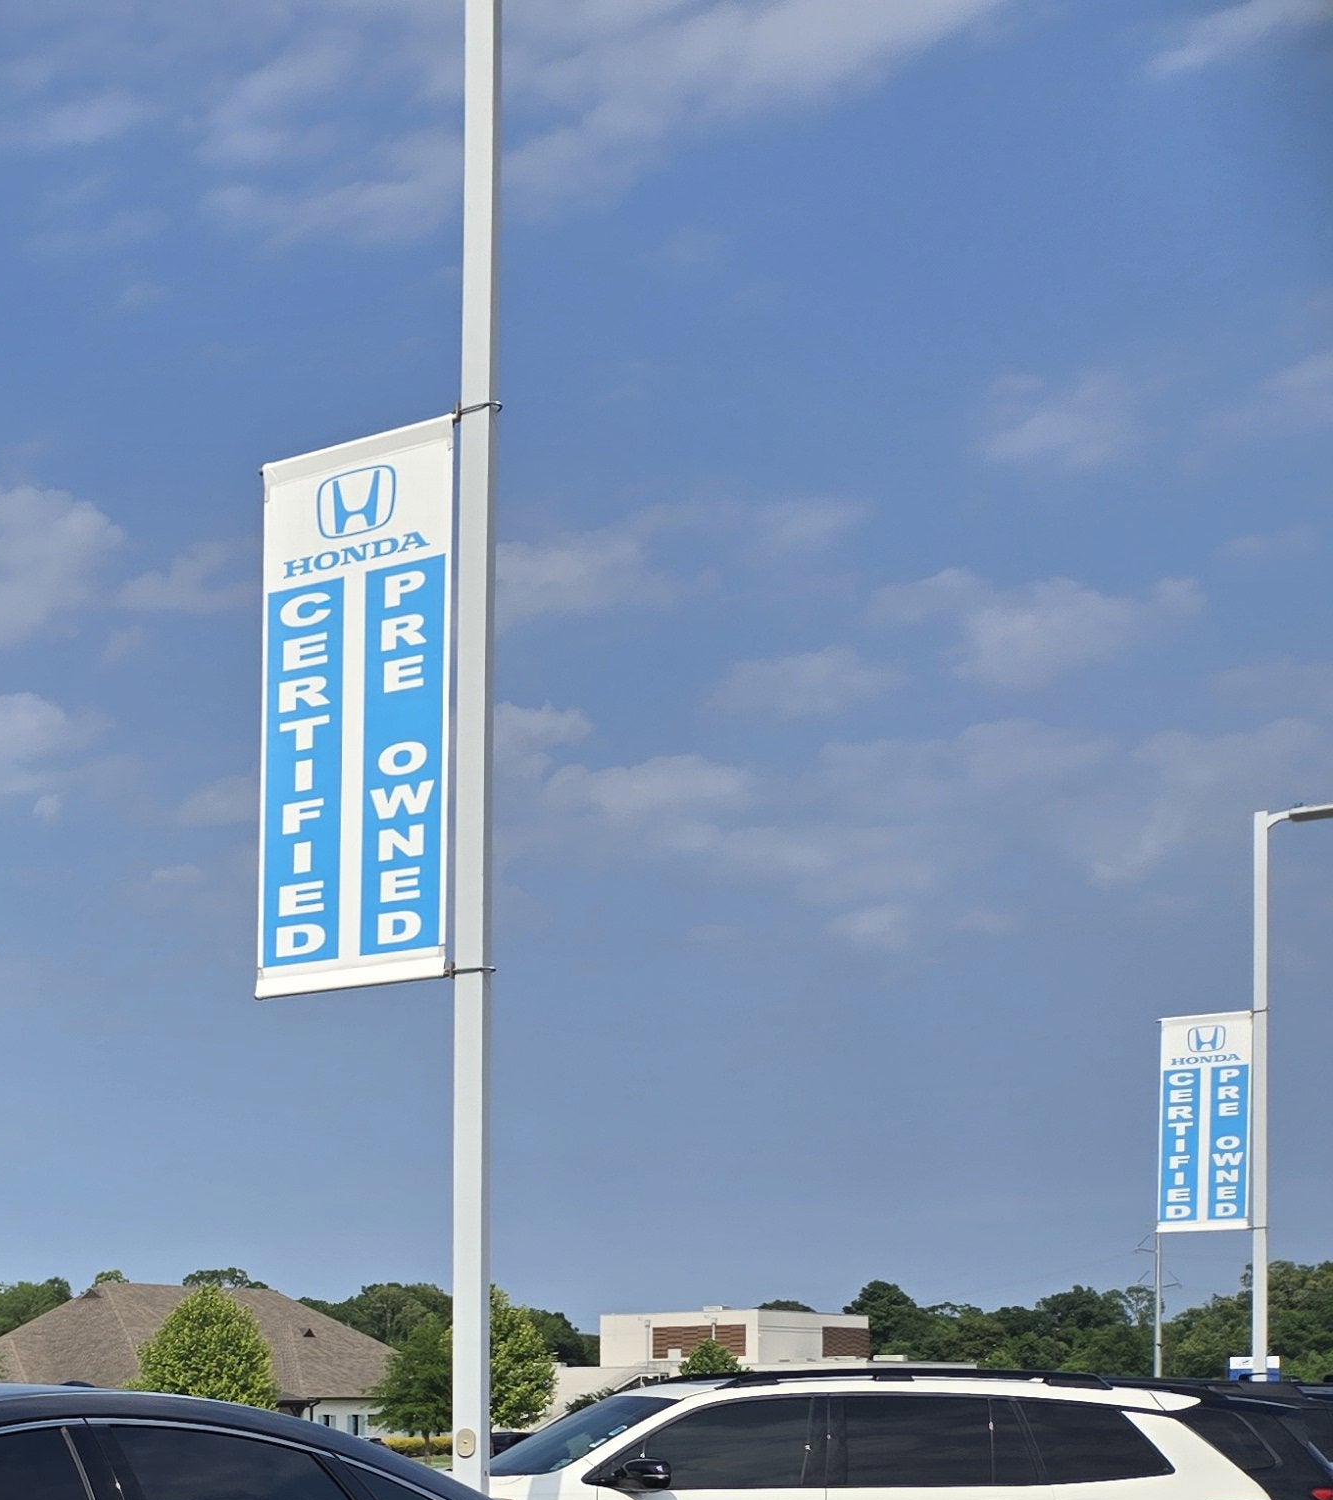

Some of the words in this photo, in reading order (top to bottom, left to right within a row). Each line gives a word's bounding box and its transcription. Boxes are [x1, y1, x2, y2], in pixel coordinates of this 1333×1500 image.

[282, 531, 431, 580] HONDA
[380, 569, 427, 694] PRE
[275, 591, 332, 959] CERTIFIED
[369, 741, 434, 947] OWNED
[1171, 1054, 1241, 1066] HONDA
[1218, 1069, 1240, 1116] PRE
[1166, 1073, 1194, 1219] CERTIFIED
[1213, 1136, 1243, 1217] OWNED
